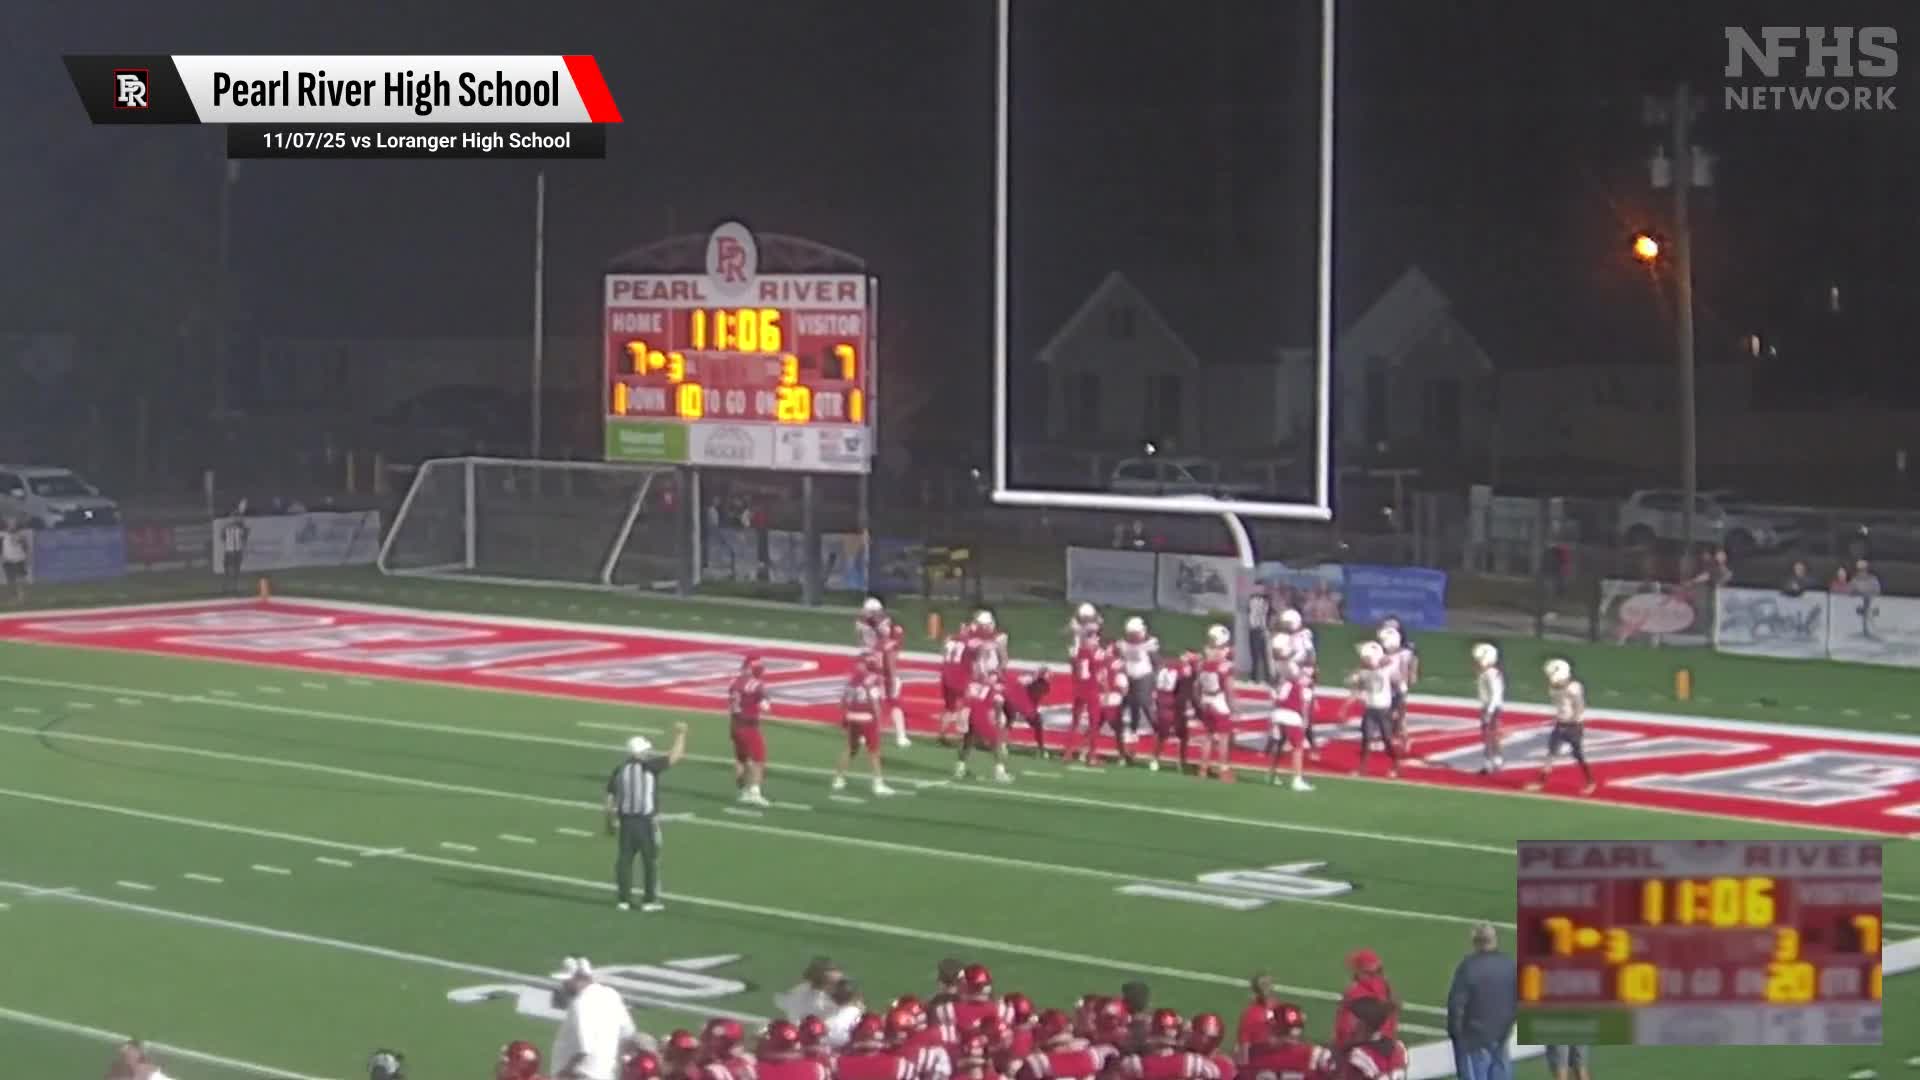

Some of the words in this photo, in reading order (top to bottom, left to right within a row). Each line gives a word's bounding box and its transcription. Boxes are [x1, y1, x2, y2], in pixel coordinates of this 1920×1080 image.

[613, 280, 707, 301] PEARL
[759, 281, 857, 302] RIVER
[612, 313, 662, 333] HOME
[692, 308, 781, 352] 11:06
[797, 314, 861, 335] VISITOR
[666, 352, 686, 383] 3
[781, 352, 799, 386] 3
[778, 386, 811, 423] 20
